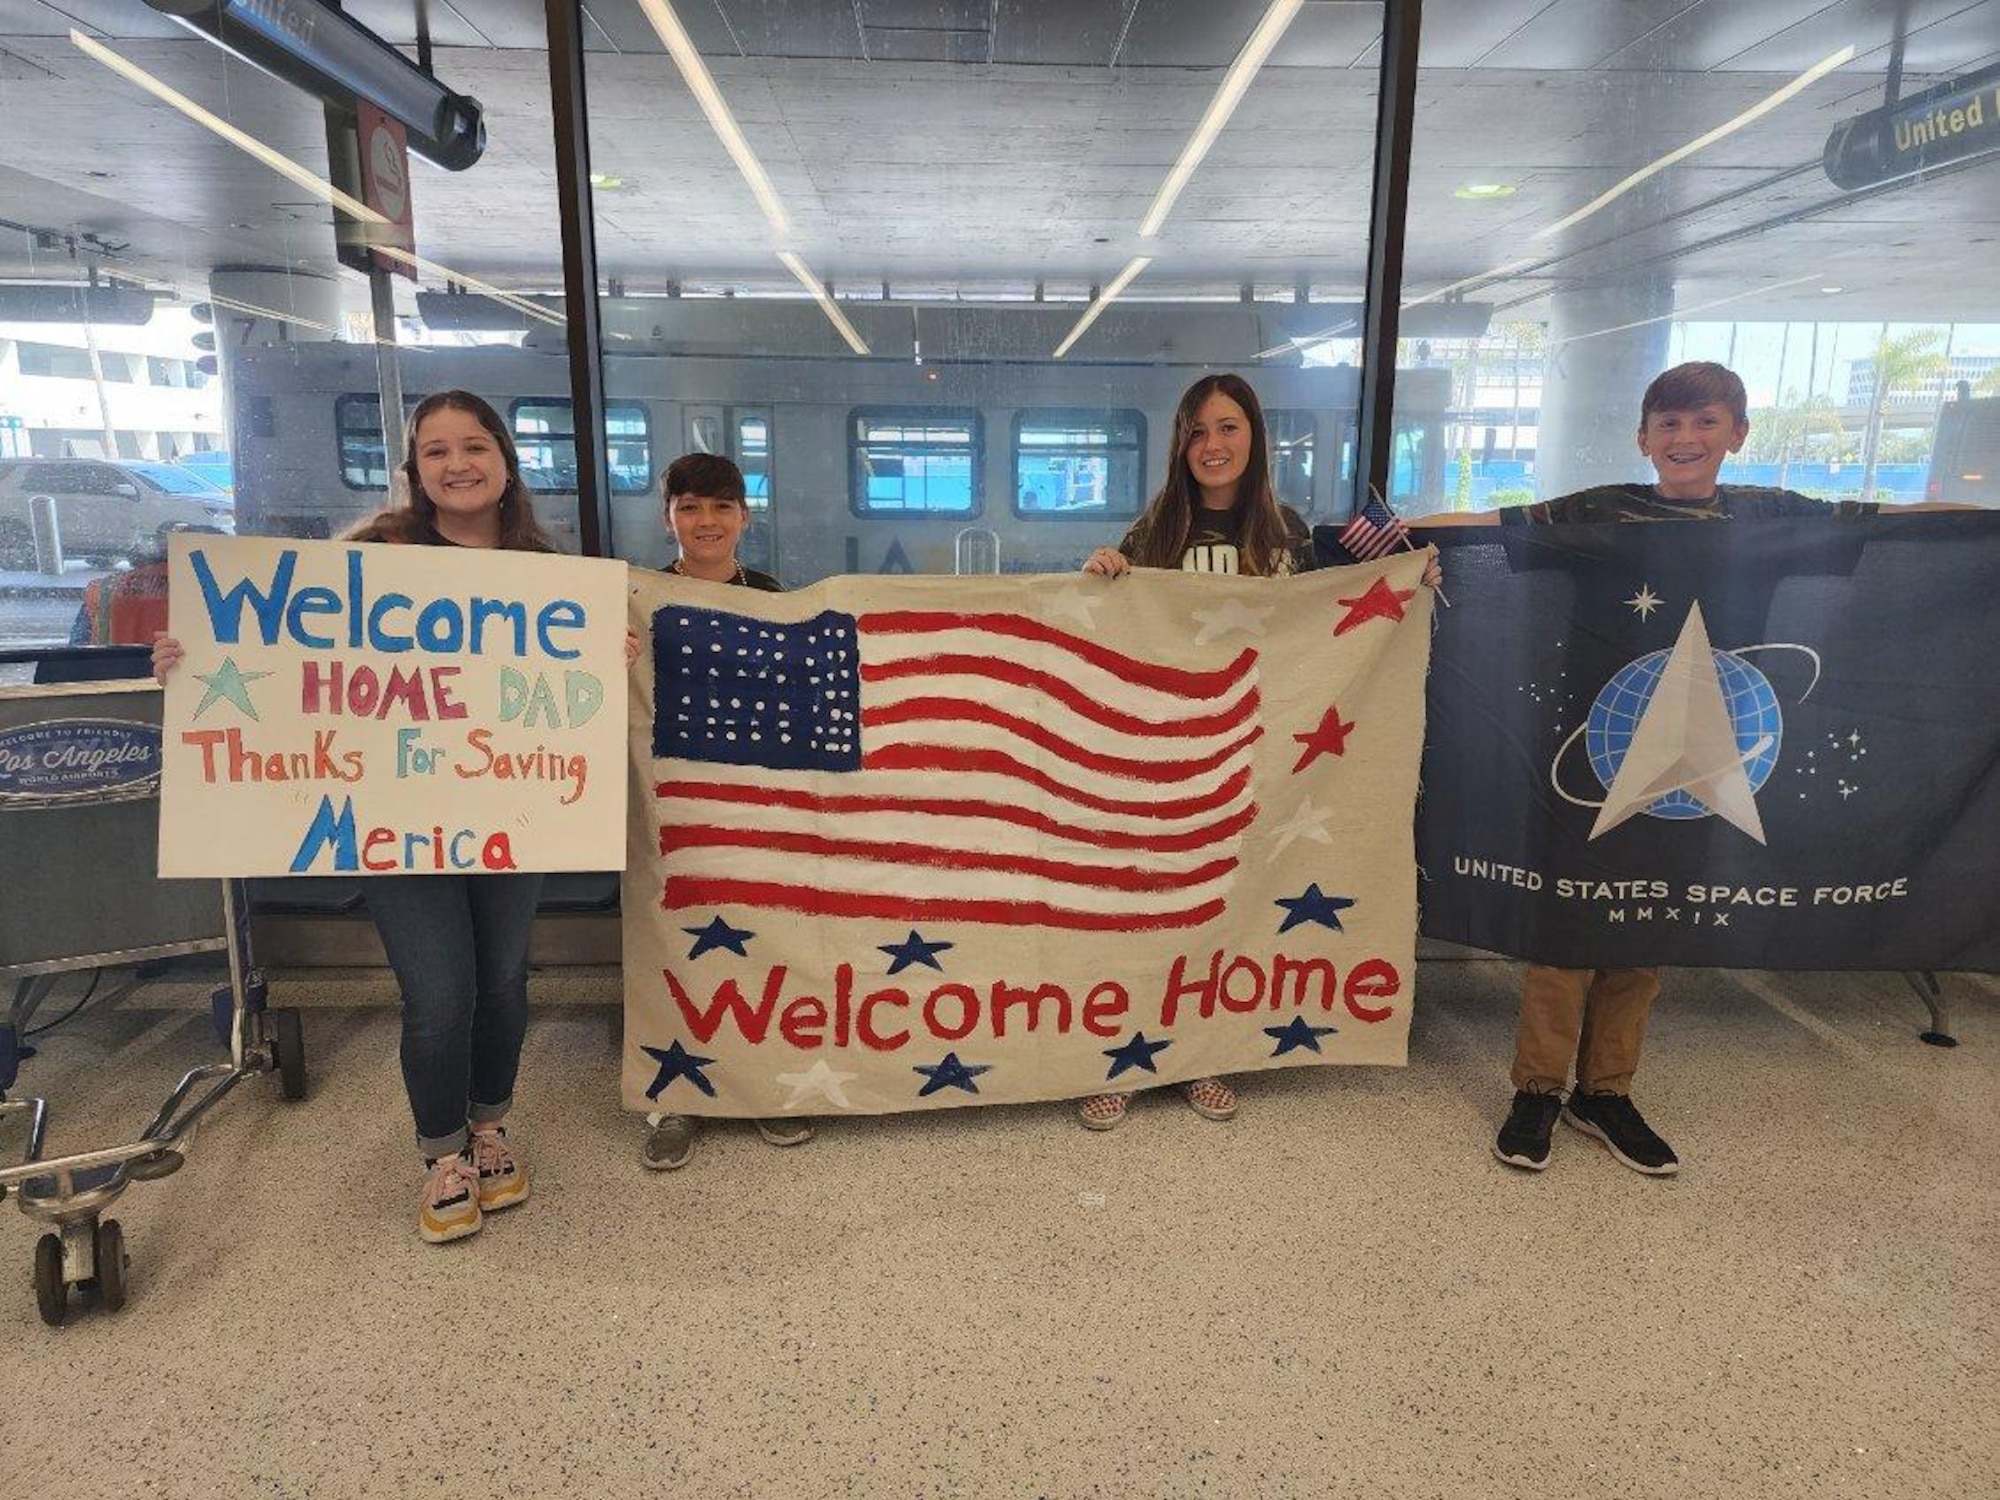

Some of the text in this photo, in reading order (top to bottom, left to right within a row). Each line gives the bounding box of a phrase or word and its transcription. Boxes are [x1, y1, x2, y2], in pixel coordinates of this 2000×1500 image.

[1895, 95, 1983, 151] United
[189, 550, 586, 660] Welcome
[302, 661, 604, 730] HOME DAD
[43, 742, 152, 771] Angeles
[396, 728, 446, 779] For
[454, 729, 587, 805] Saving
[1454, 856, 1908, 907] UNITED STATES SPACE FORCE
[664, 949, 1400, 1051] Welcome Home
